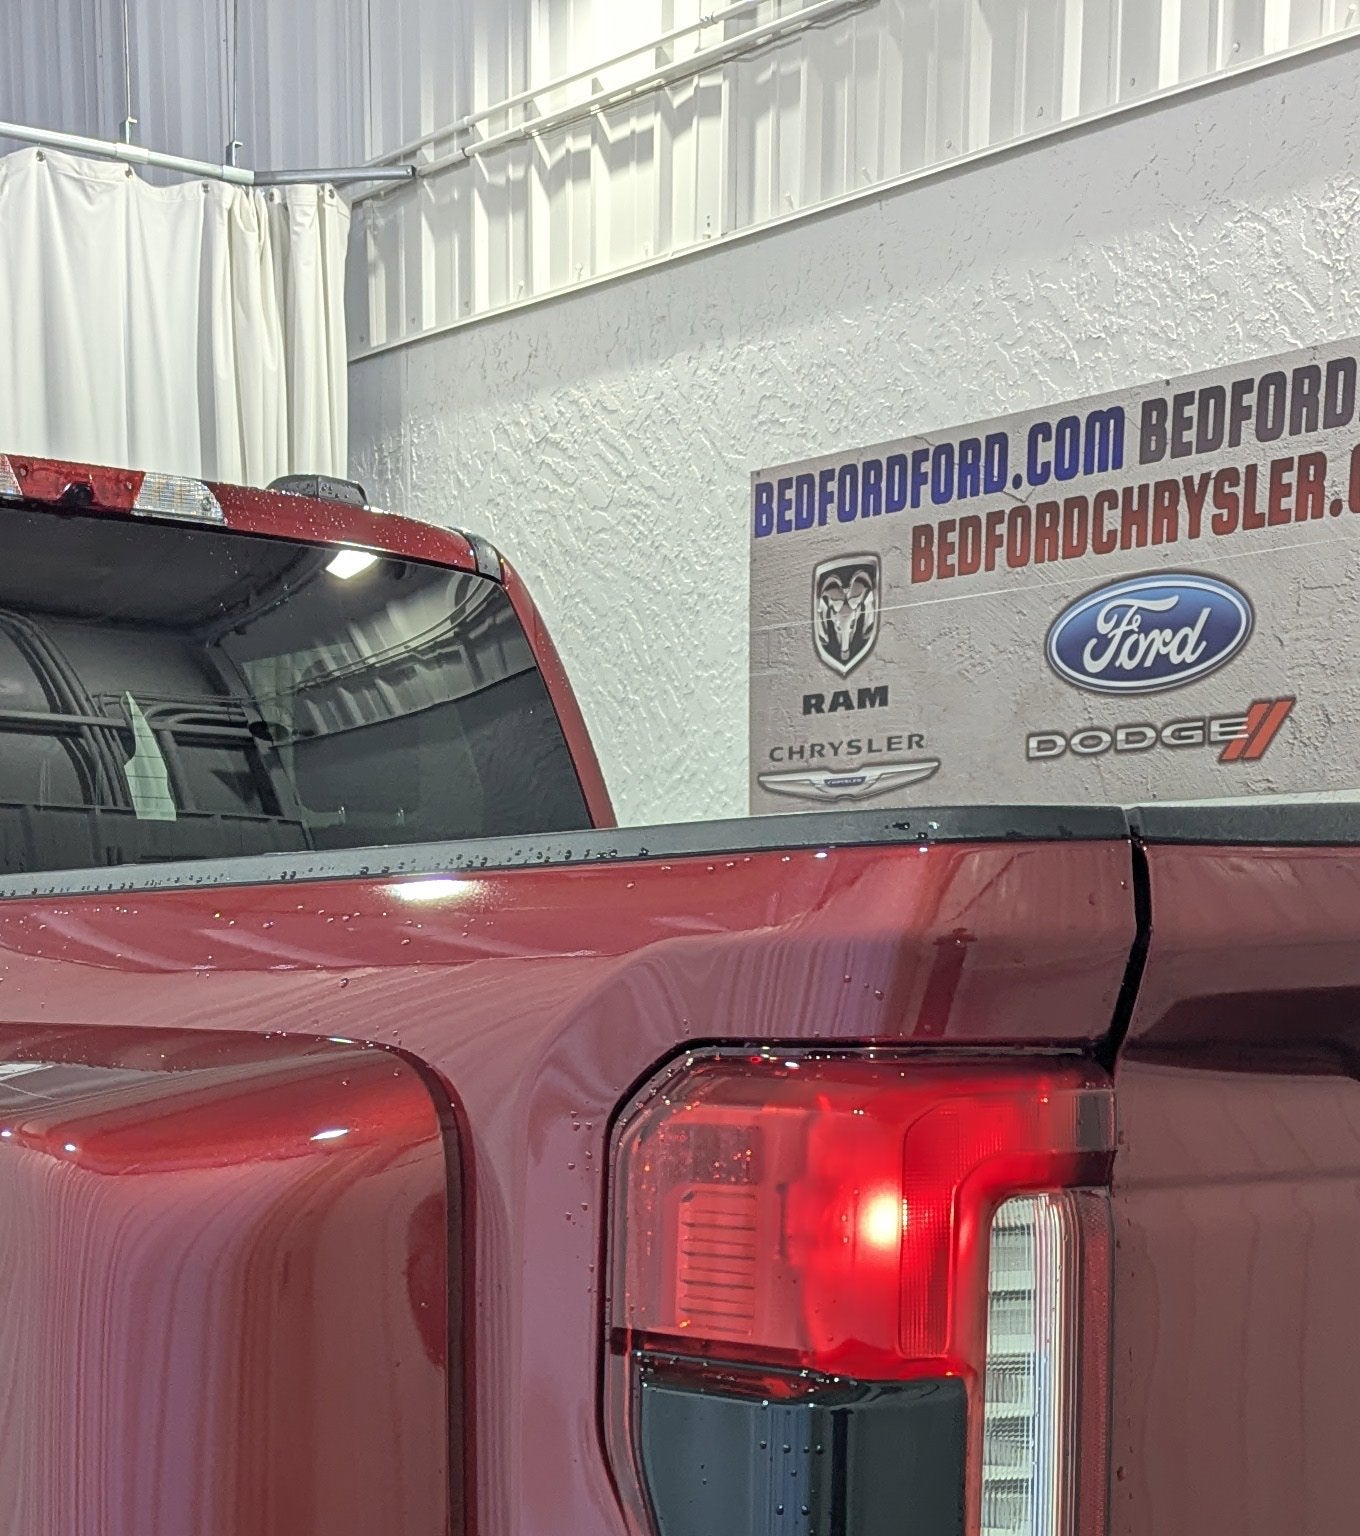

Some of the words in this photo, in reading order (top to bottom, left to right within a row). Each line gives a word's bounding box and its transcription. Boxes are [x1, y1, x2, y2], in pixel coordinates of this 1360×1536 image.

[753, 405, 1126, 538] BEDFORDFORD.COM
[1082, 594, 1212, 674] Ford
[802, 685, 890, 716] RAM
[768, 733, 926, 763] CHRYSLER
[1027, 715, 1250, 762] DODGE
